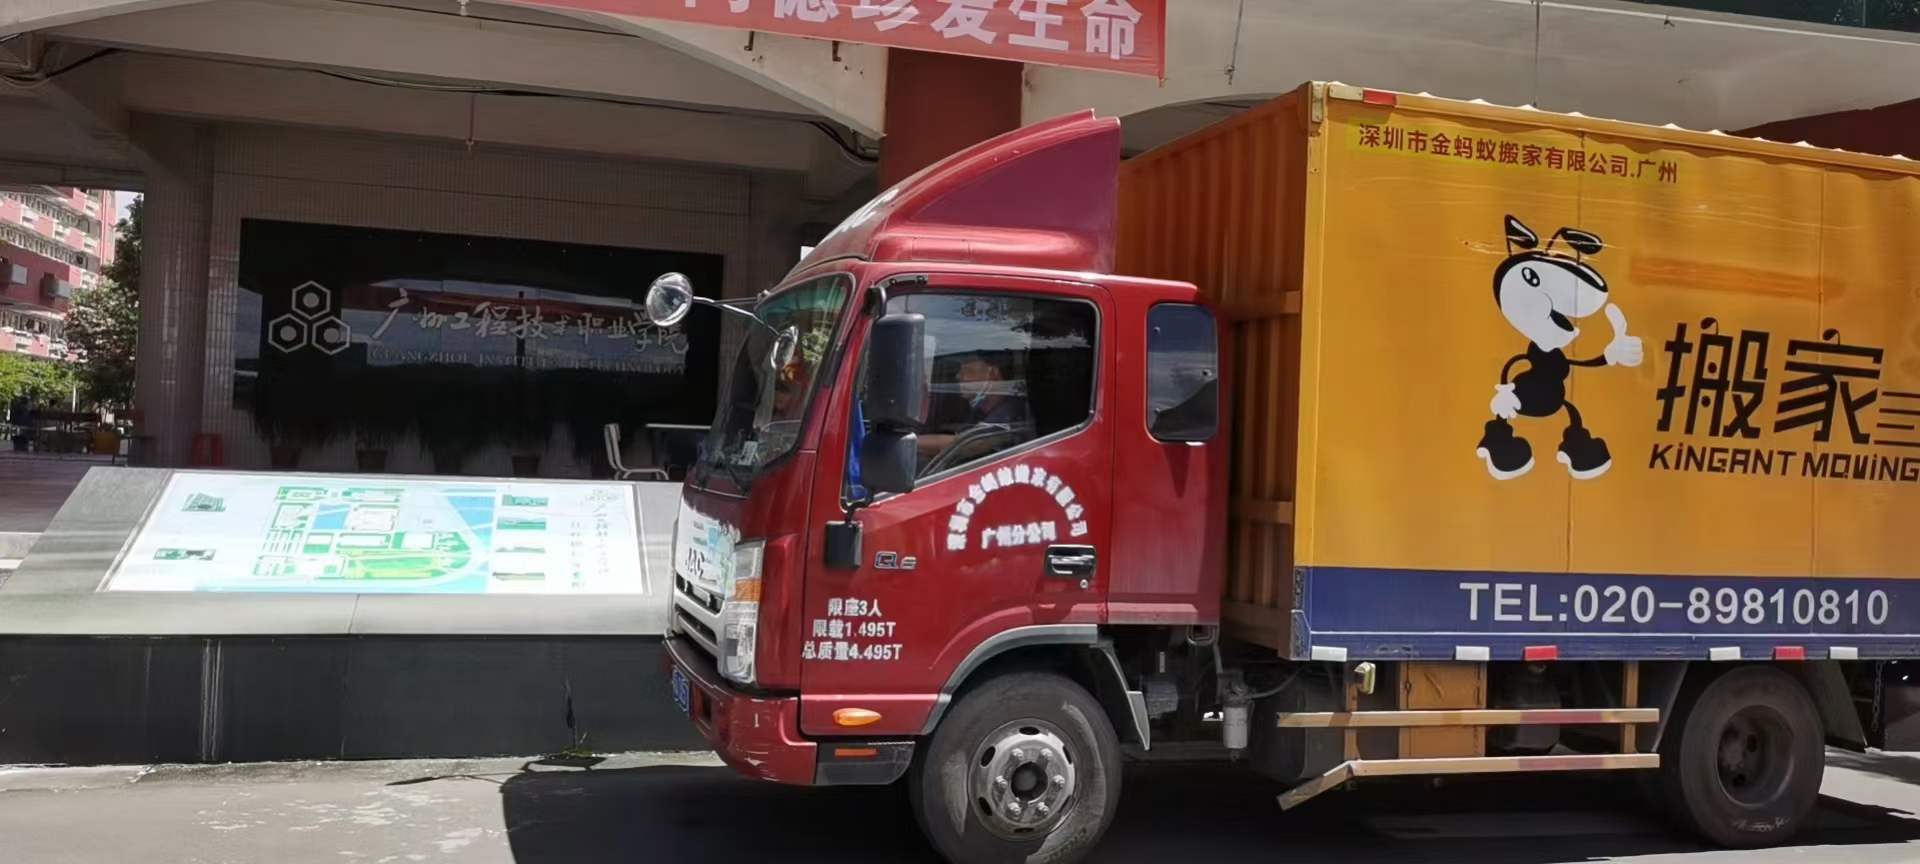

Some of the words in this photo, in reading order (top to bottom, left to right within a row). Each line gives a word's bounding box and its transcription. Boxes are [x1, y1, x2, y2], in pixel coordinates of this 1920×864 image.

[1655, 318, 1884, 445] 搬家
[827, 597, 883, 617] 限座3人
[1459, 582, 1889, 625] TEL:020-89810810
[801, 640, 903, 661] 总质量4.495T
